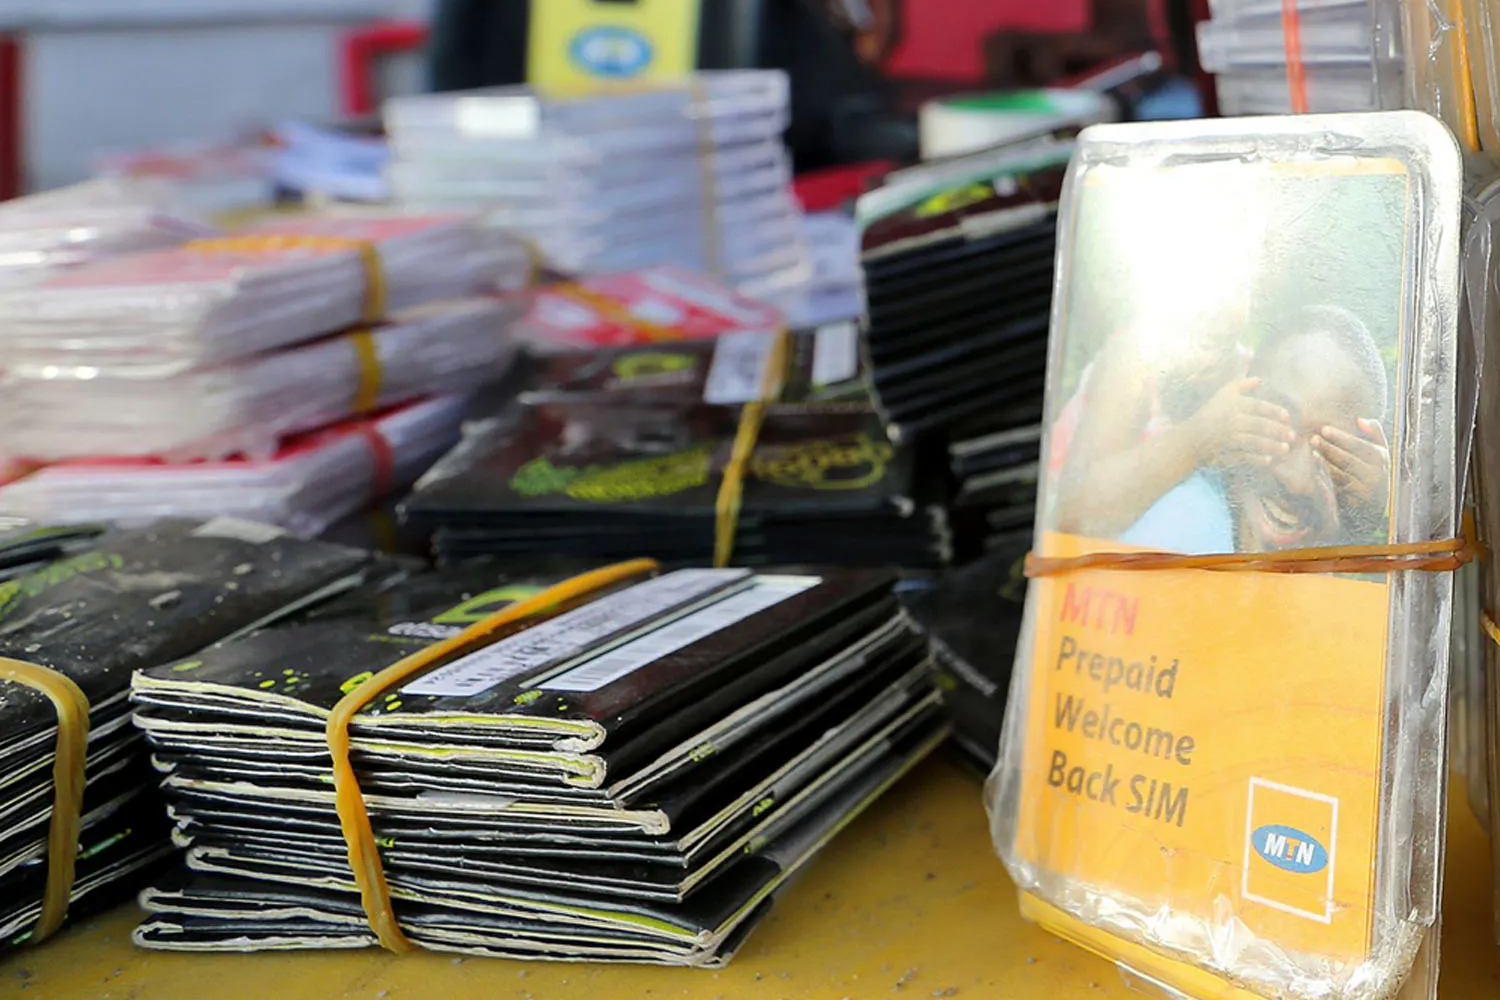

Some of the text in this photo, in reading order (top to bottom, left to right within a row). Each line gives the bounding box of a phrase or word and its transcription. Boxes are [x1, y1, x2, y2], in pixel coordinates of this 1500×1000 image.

[1059, 582, 1141, 637] MTN
[1054, 636, 1181, 700] Prepaid
[1053, 692, 1197, 766] Welcome
[1047, 749, 1191, 829] Back SIM
[1263, 831, 1317, 868] MTN
